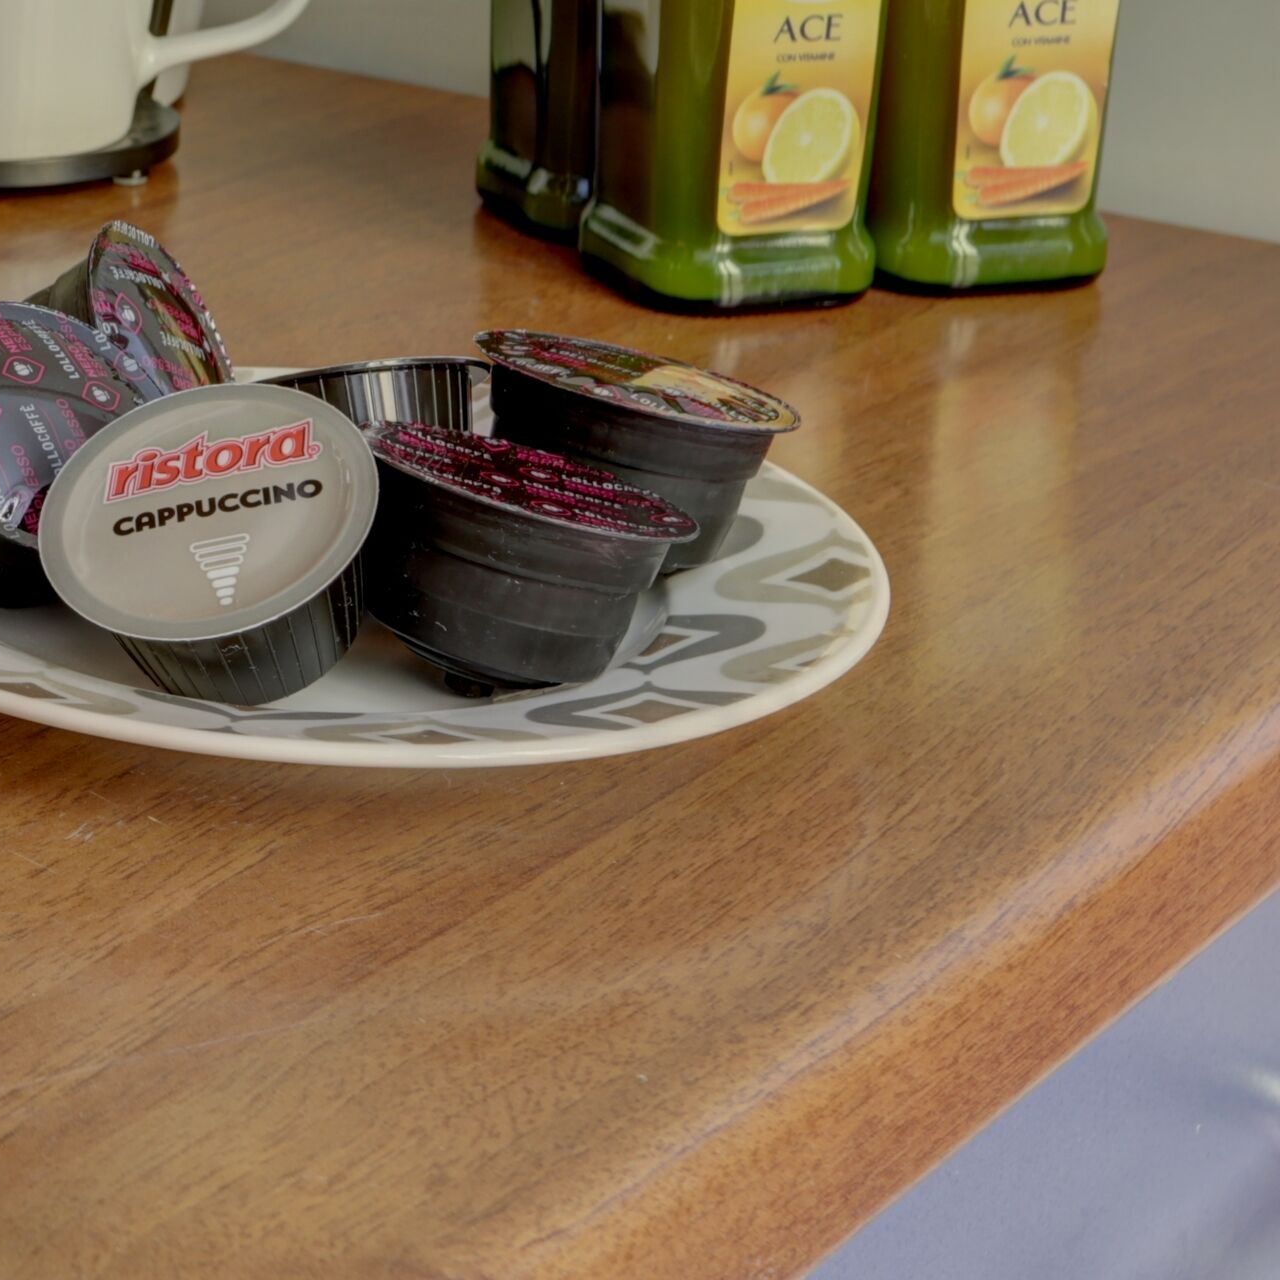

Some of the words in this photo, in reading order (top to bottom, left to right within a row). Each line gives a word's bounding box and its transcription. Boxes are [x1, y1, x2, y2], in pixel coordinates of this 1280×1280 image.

[773, 14, 843, 44] ACE
[107, 422, 312, 501] ristora
[113, 478, 323, 537] CAPPUCCINO
